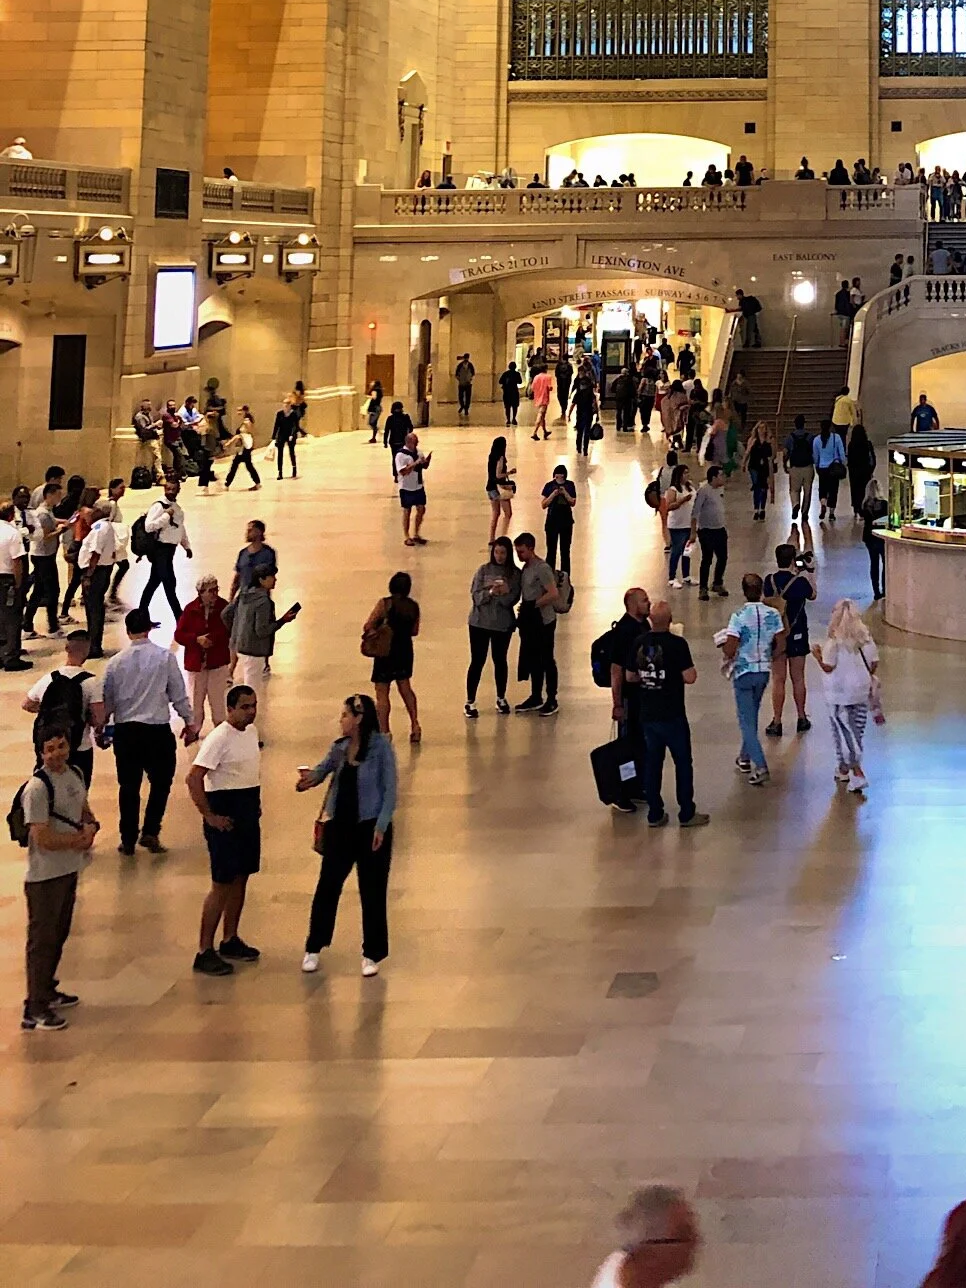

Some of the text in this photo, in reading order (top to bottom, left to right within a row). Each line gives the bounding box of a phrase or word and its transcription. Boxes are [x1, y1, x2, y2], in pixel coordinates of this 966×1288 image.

[460, 256, 549, 278] TRACKS 21 TO 11
[591, 255, 685, 277] LEXINGTON AVE
[796, 253, 837, 261] BALCONY
[532, 297, 556, 309] 42ND
[558, 292, 592, 303] STREET
[596, 289, 636, 298] PASSAGE
[645, 289, 684, 298] SUBWAY
[930, 343, 960, 355] TRACKS
